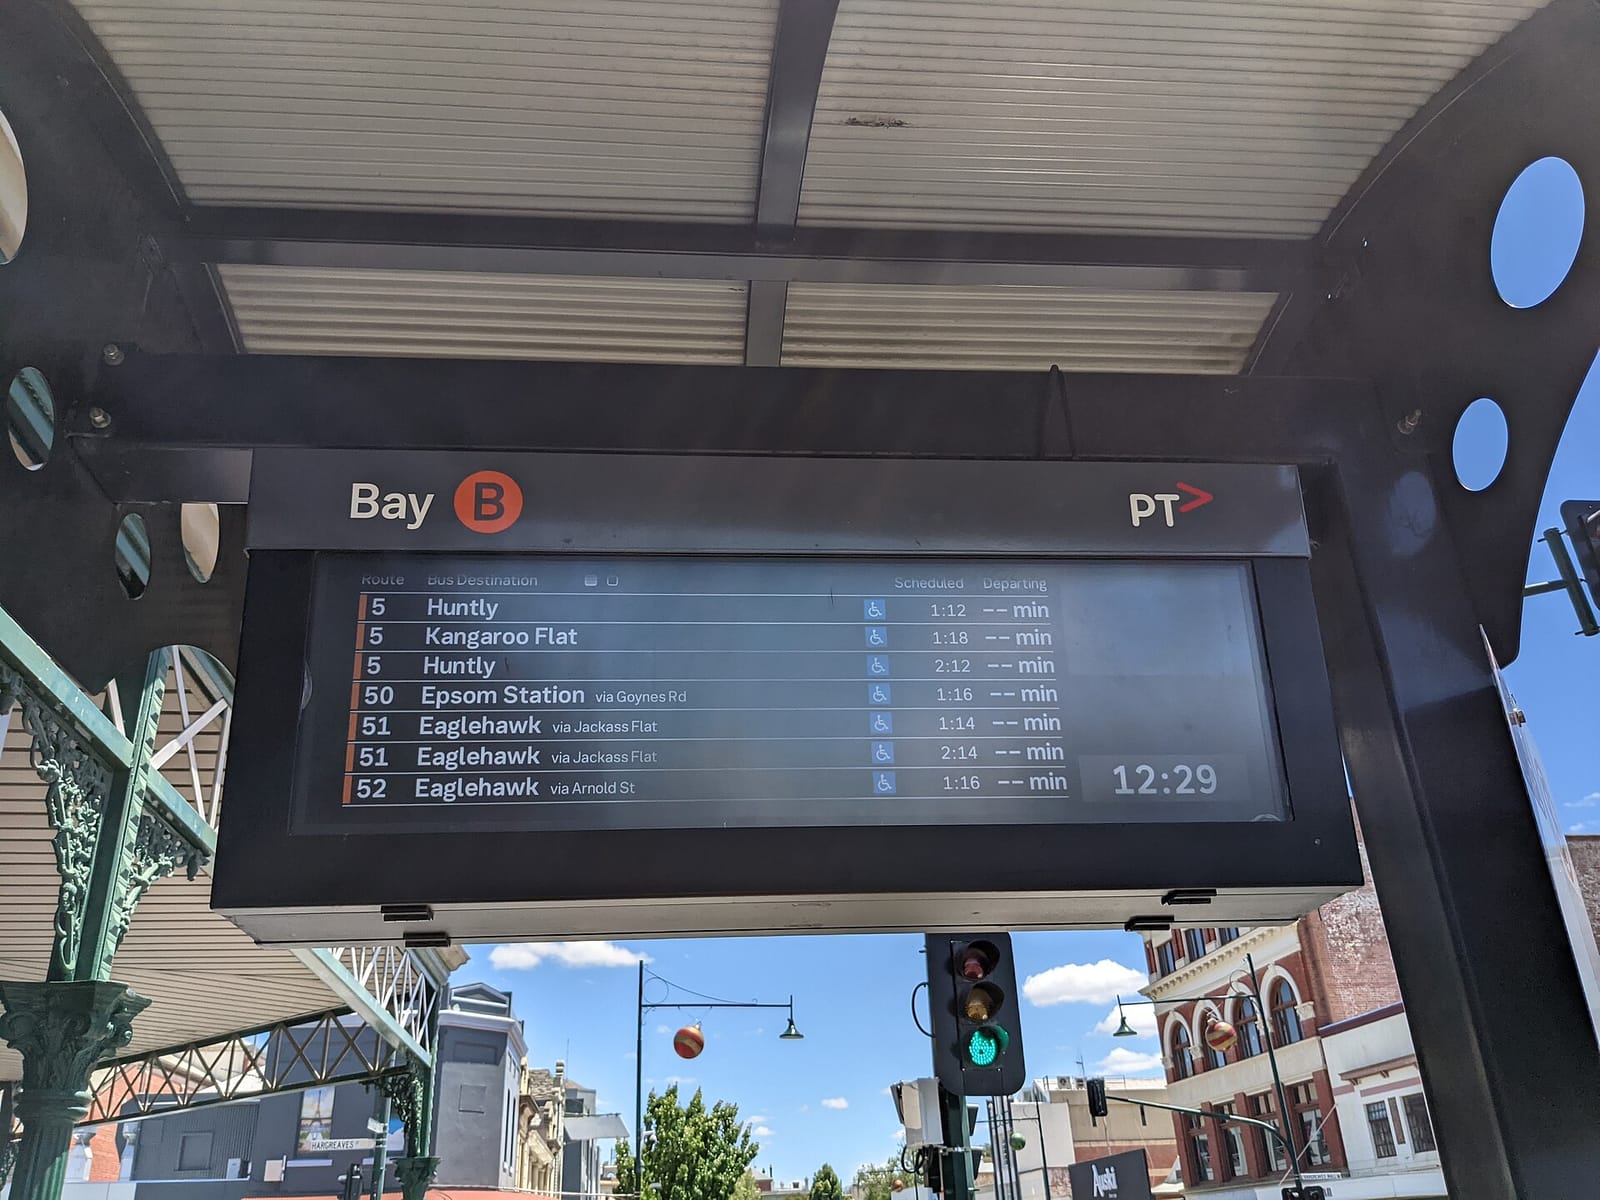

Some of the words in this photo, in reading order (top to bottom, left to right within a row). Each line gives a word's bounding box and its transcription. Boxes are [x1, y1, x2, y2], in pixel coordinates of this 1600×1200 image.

[350, 483, 434, 530] Bay
[474, 482, 505, 521] B
[361, 575, 404, 585] Route
[428, 576, 454, 586] Bus
[457, 575, 538, 586] Destination
[895, 577, 964, 589] Scheduled
[983, 578, 1048, 593] Departing
[371, 598, 386, 615] 5
[427, 598, 499, 620] Huntly
[931, 604, 967, 617] 1:12
[1013, 602, 1049, 618] min
[369, 627, 383, 645] 5
[426, 627, 529, 649] Kangaroo
[535, 627, 578, 644] Flat
[932, 632, 968, 644] 1:18
[1016, 630, 1052, 645] min
[367, 657, 381, 674] 5
[424, 656, 496, 678] Huntly
[935, 660, 971, 673] 2:12
[1018, 658, 1055, 673] min
[364, 687, 394, 705] 50
[421, 687, 497, 708] Epsom
[503, 686, 585, 704] Station
[596, 692, 614, 703] via
[617, 692, 666, 706] Goynes
[669, 692, 686, 703] Rd
[937, 688, 973, 701] 1:16
[1021, 686, 1058, 702] min
[362, 717, 391, 735] 51
[419, 716, 542, 740] Eaglehawk
[553, 722, 571, 733] via
[574, 721, 629, 733] Jackass
[631, 721, 657, 733] Flat
[939, 717, 975, 730] 1:14
[1024, 714, 1061, 731] min
[359, 748, 388, 766] 51
[417, 747, 541, 770] Eaglehawk
[551, 753, 570, 764] via
[573, 752, 628, 764] Jackass
[631, 752, 657, 763] Flat
[941, 746, 978, 760] 2:14
[1027, 743, 1064, 760] min
[943, 776, 980, 789] 1:16
[1030, 773, 1067, 790] min
[1113, 764, 1217, 794] 12:29
[357, 779, 386, 798] 52
[415, 778, 539, 802] Eaglehawk
[551, 784, 569, 795] via
[572, 783, 617, 794] Arnold
[619, 782, 635, 794] St
